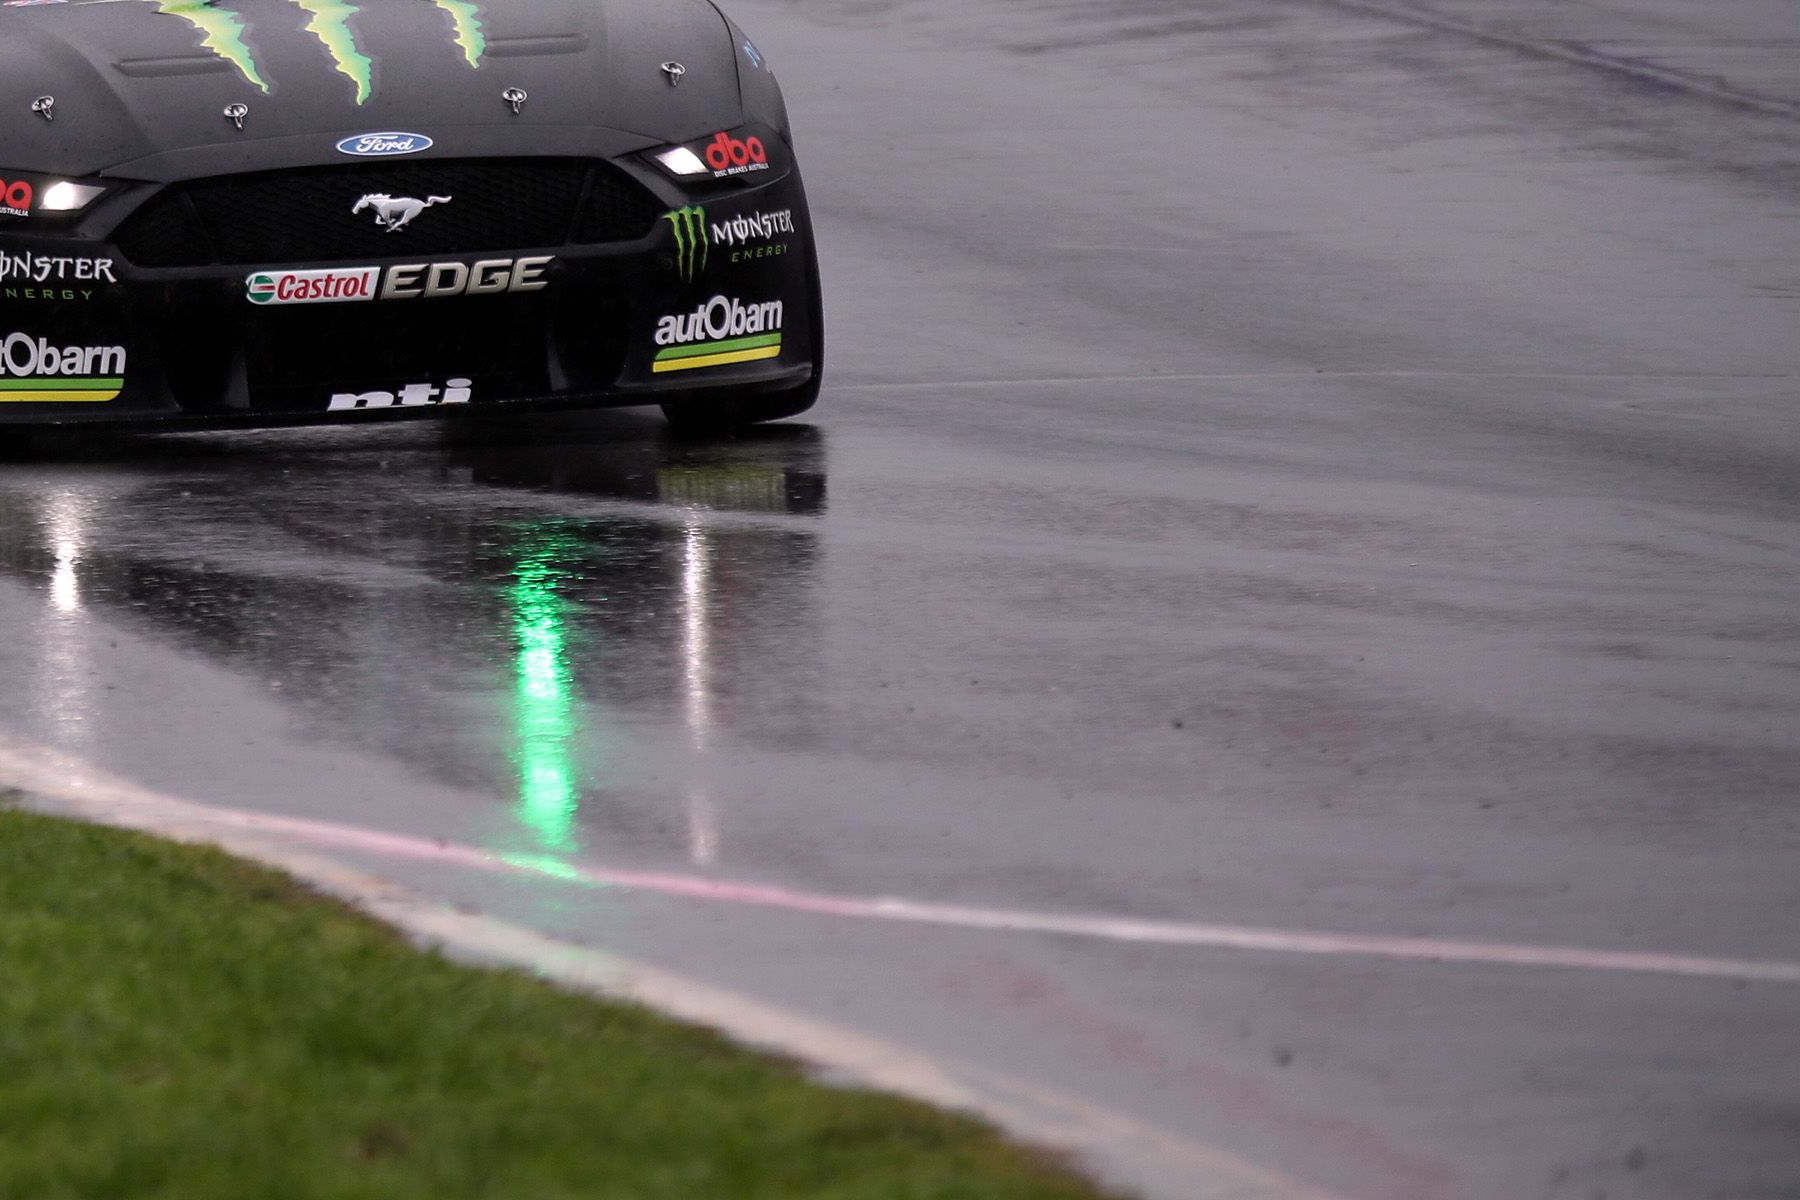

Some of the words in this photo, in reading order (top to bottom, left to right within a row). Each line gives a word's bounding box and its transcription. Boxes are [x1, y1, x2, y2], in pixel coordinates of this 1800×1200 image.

[356, 135, 415, 153] Ford
[706, 131, 767, 170] dba
[712, 209, 795, 246] MONSTER
[731, 243, 789, 263] ENERGY
[277, 272, 369, 301] Castrol
[381, 255, 557, 300] EDGE
